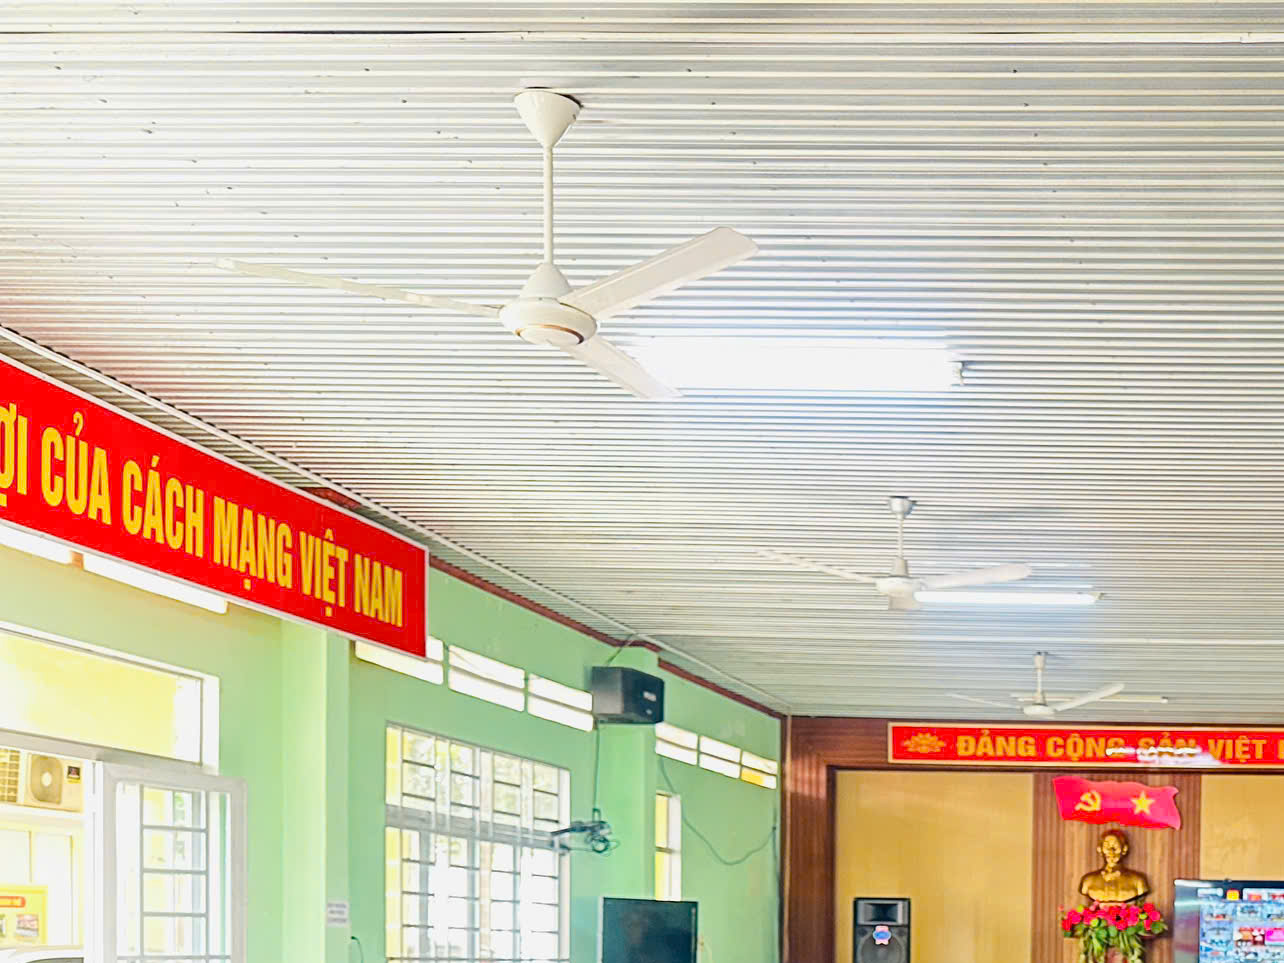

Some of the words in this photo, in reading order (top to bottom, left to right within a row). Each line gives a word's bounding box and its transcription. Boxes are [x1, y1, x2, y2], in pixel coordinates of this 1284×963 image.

[41, 411, 112, 526] CỦA
[122, 455, 205, 559] CÁCH
[213, 496, 293, 591] MẠNG
[300, 528, 349, 617] VIỆT
[354, 553, 403, 628] NAM
[956, 729, 1036, 757] ĐẢNG
[1207, 735, 1267, 763] VIỆT
